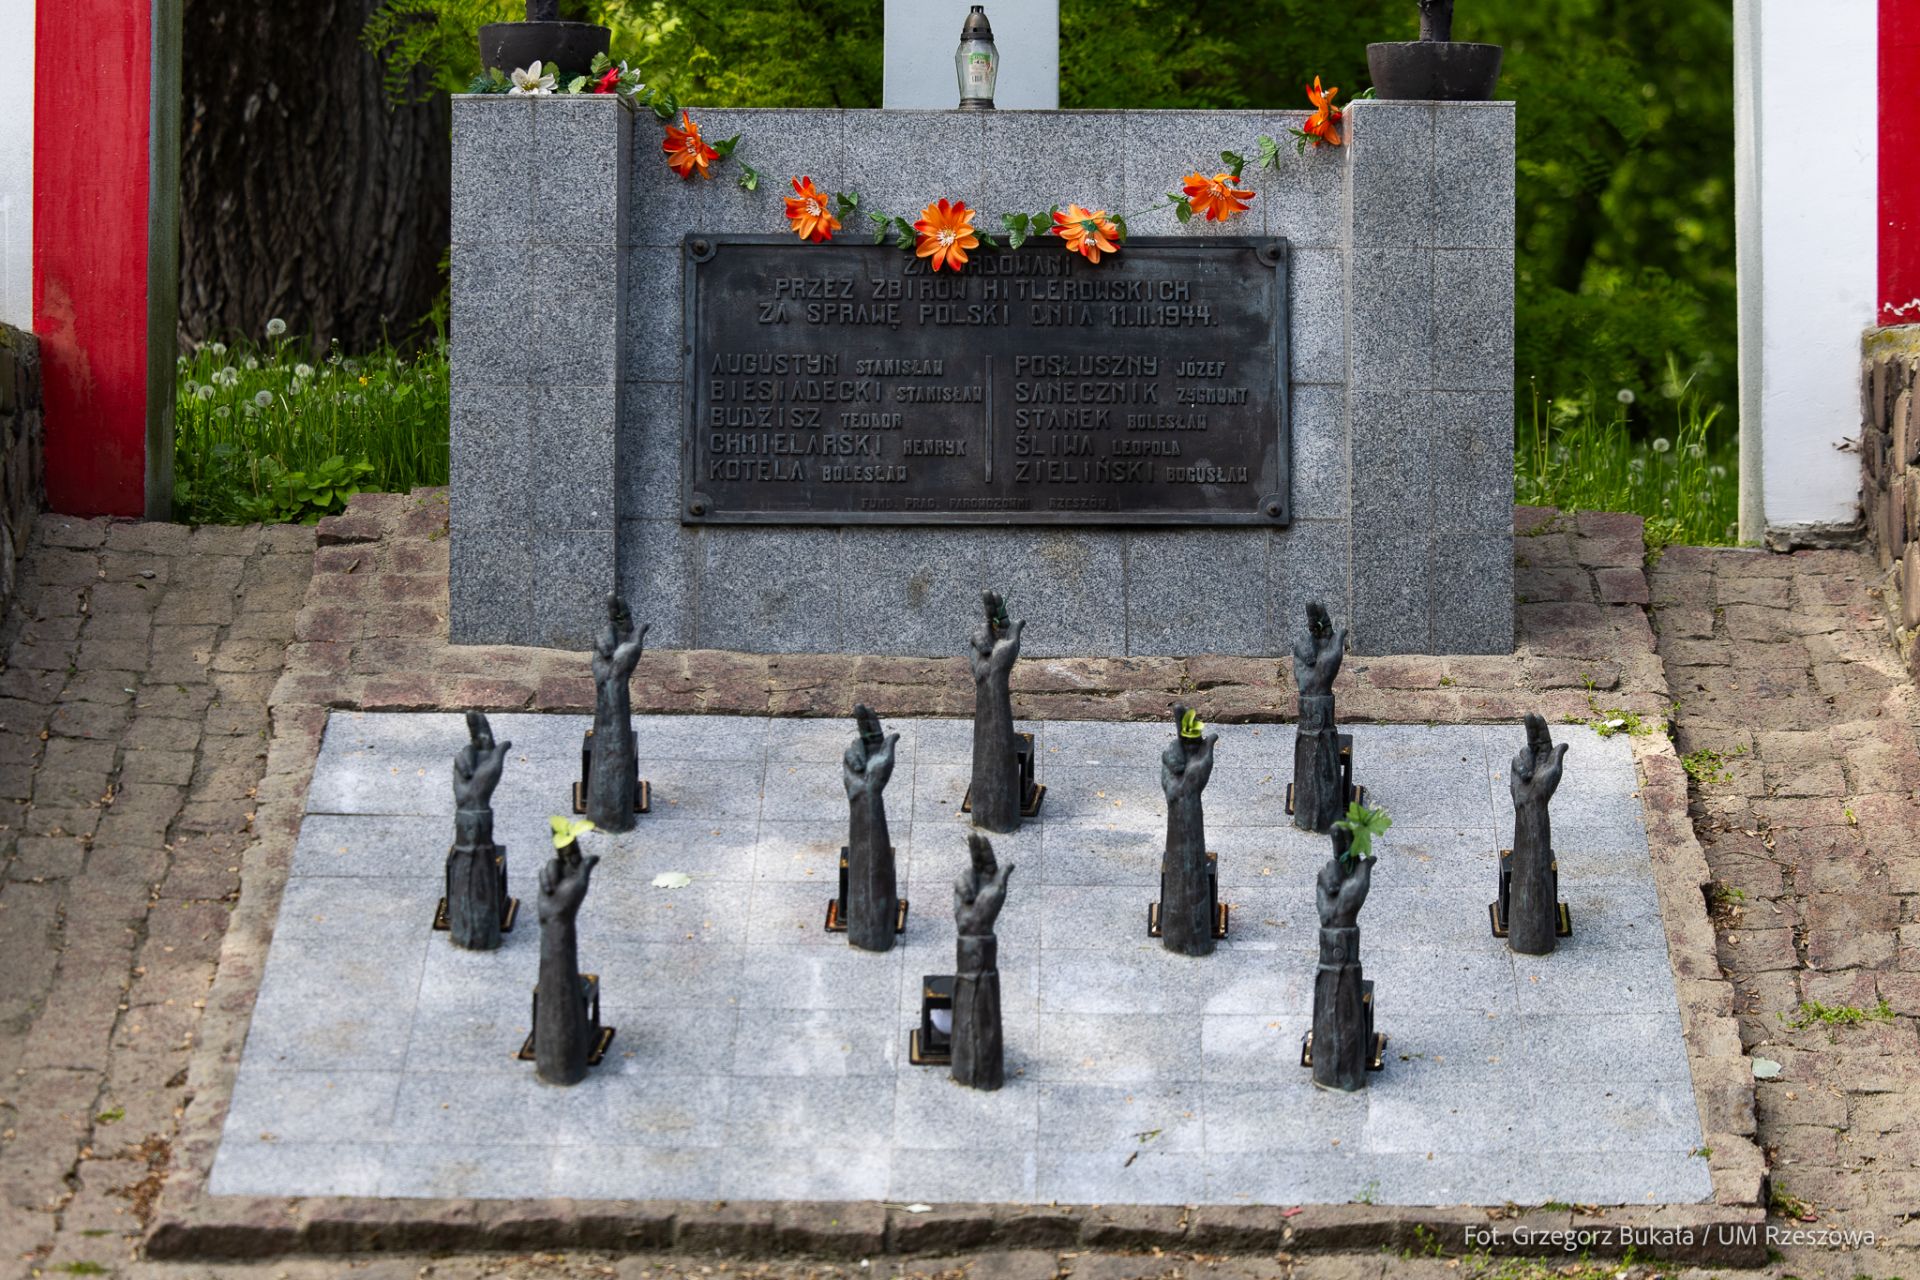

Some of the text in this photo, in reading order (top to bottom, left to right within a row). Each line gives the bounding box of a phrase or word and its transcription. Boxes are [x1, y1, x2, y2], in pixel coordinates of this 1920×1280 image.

[903, 255, 1072, 276] ZARDOWANI
[775, 278, 854, 299] PRZEZ
[983, 279, 1190, 301] HITLEROWSKICH
[758, 302, 789, 324] ZA
[807, 303, 902, 329] SPRAWĘ
[919, 304, 1009, 325] POLSKI
[1031, 305, 1094, 325] DNIA
[711, 353, 944, 376] AUGUSTYN STANISŁAW
[1015, 355, 1226, 378] POSŁUSZNY JÓZEF
[710, 381, 983, 403] BIESIADECKI STANISŁAW
[1176, 387, 1248, 405] ZYGMUNT
[841, 413, 903, 429] TEODOR
[1015, 408, 1208, 431] STANEK BOLESŁAW
[709, 434, 967, 456] CHMIELARSKI HENRYK
[1015, 430, 1095, 457] ŚLIWA
[709, 460, 907, 482] KOTELA BOLESŁAW
[1015, 456, 1248, 483] ZIELIŃSKI BOGUSŁAW
